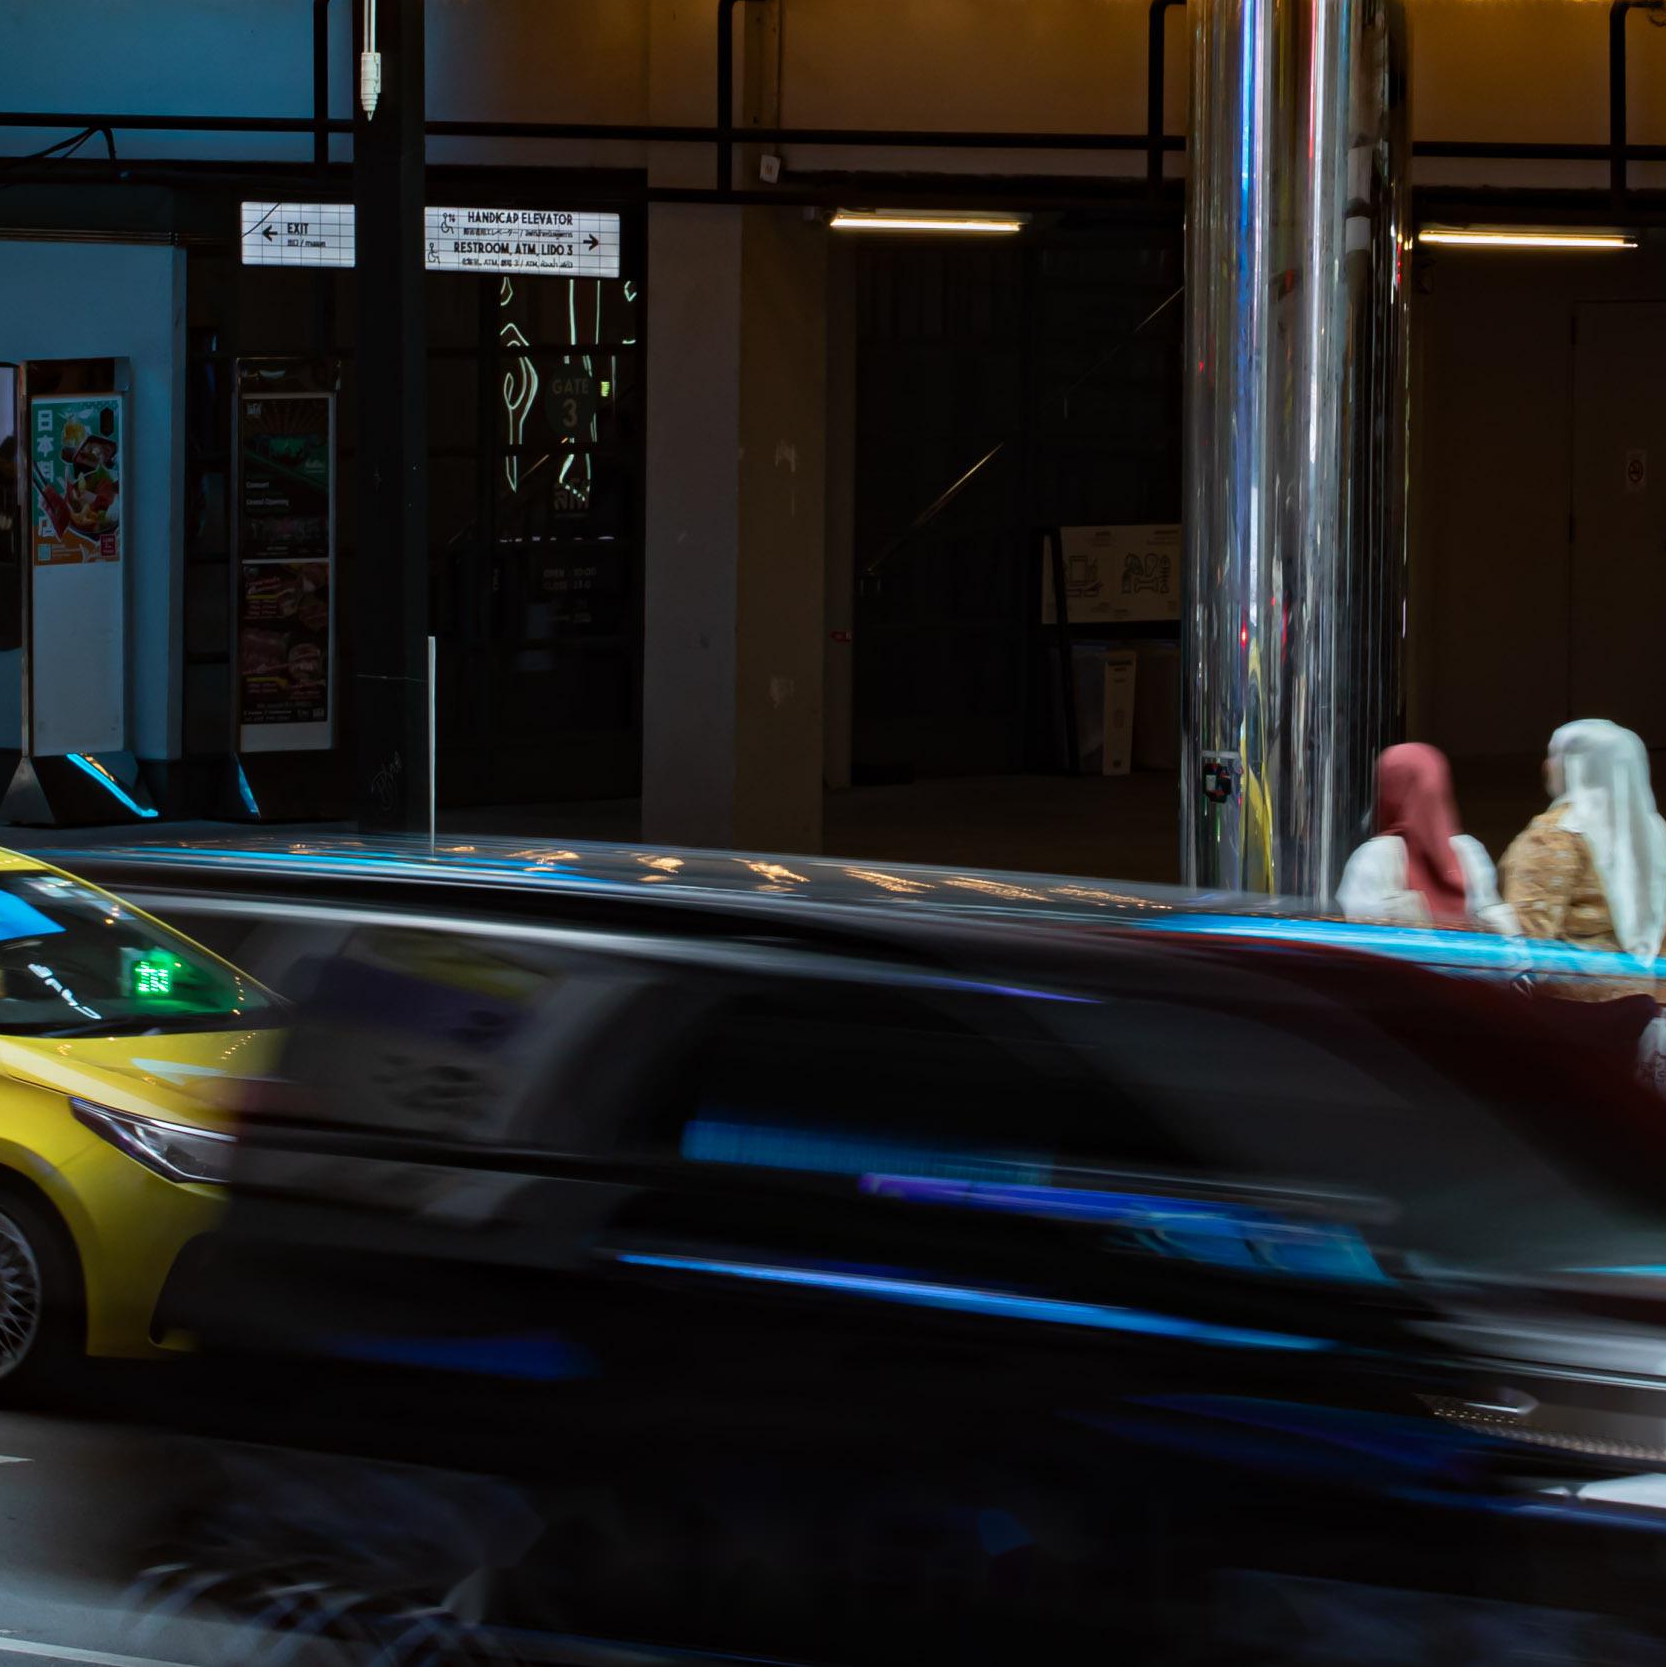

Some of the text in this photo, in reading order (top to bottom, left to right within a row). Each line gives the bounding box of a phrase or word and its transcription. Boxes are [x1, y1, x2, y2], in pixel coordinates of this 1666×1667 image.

[467, 211, 573, 225] HANDICAP ELEVATOR
[287, 222, 309, 234] EXIT
[453, 241, 573, 257] RESTROOM, ATM, LIDO 3
[551, 377, 590, 396] GATE
[562, 397, 578, 428] 3
